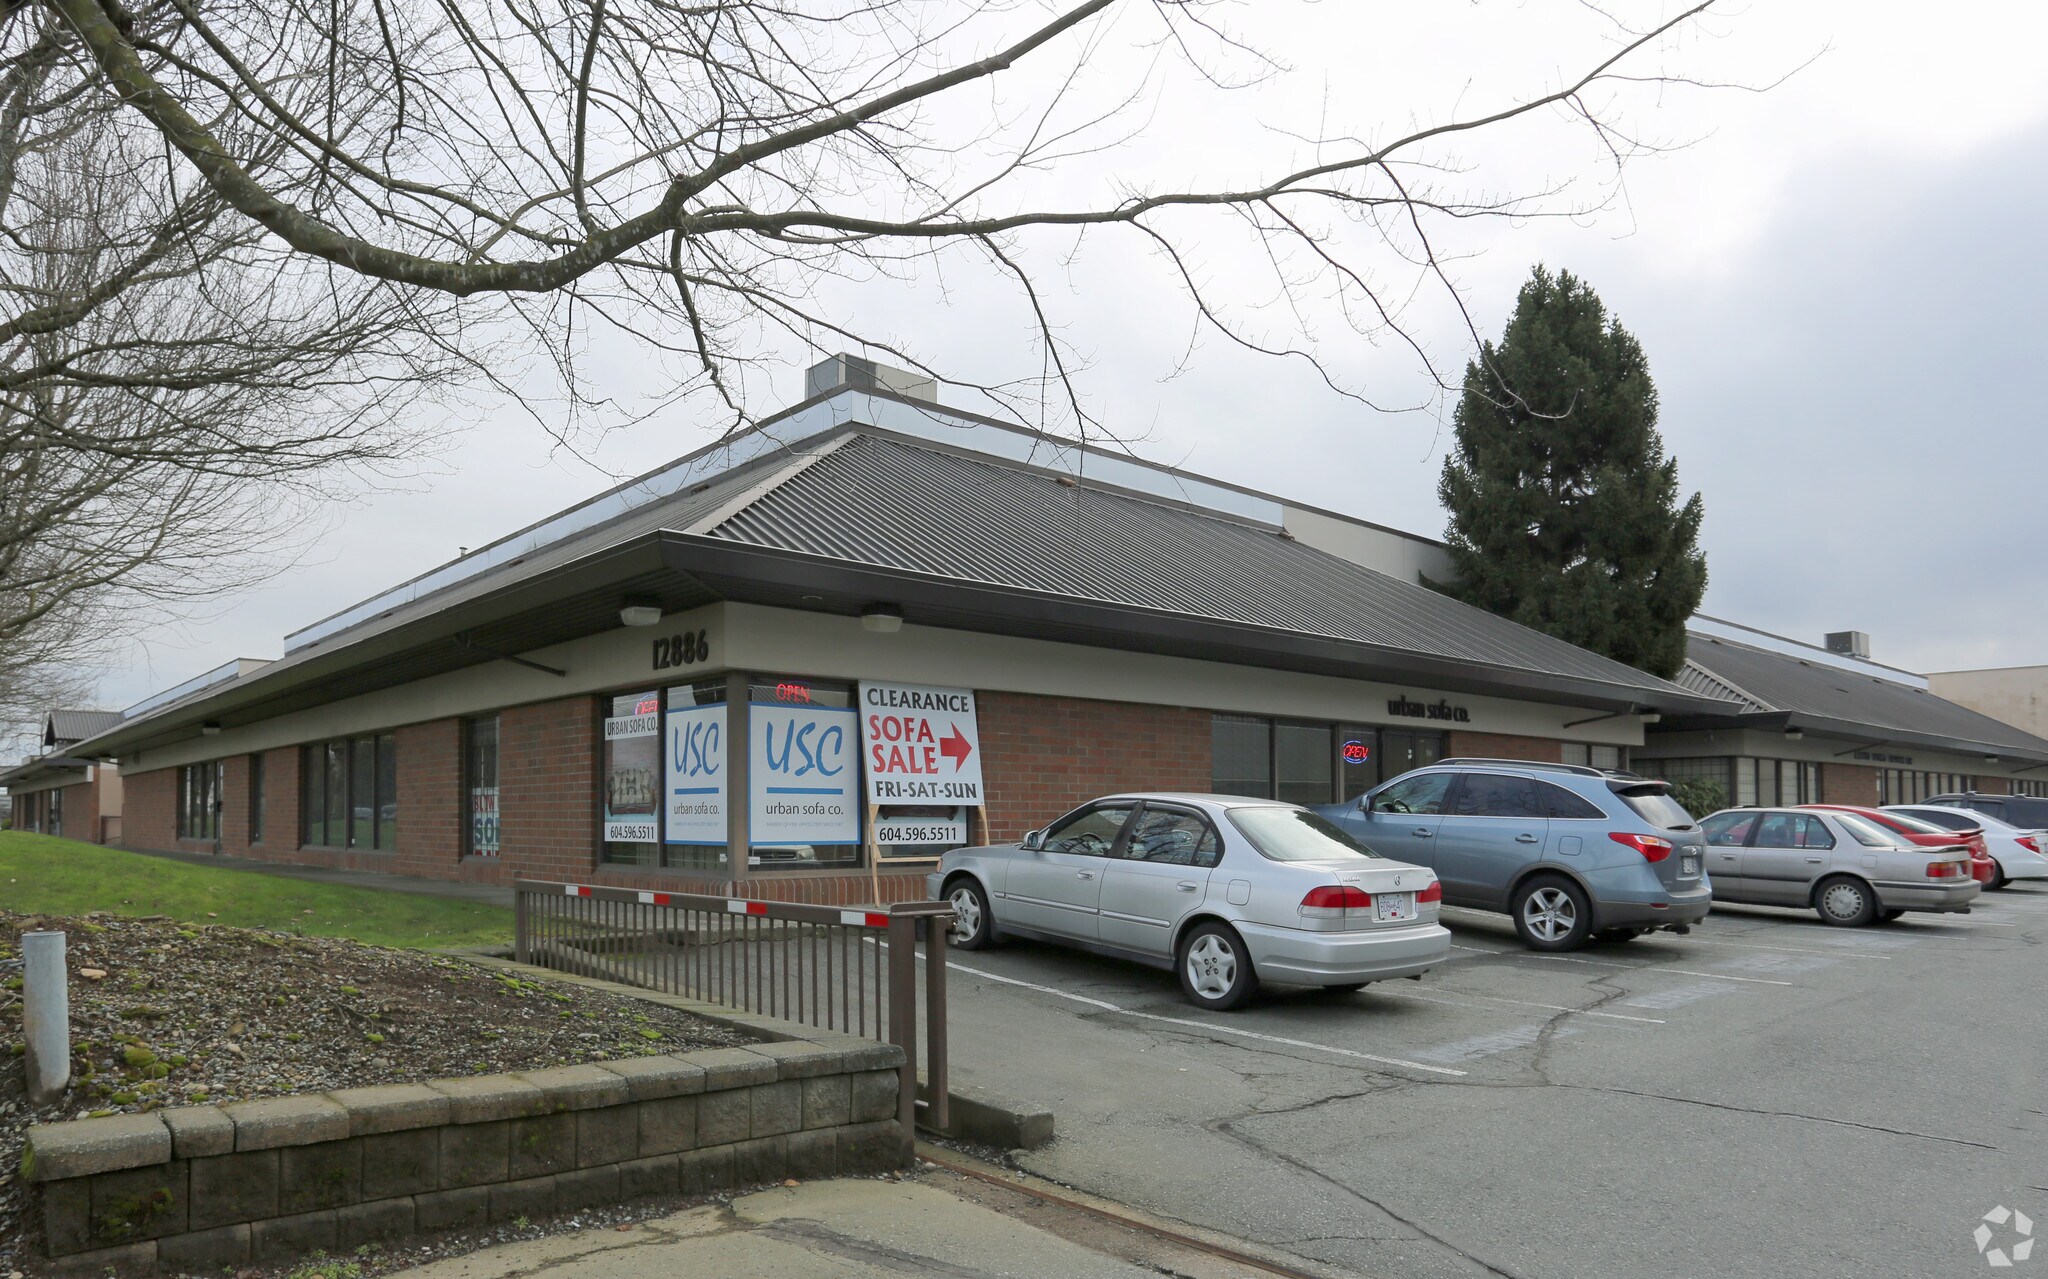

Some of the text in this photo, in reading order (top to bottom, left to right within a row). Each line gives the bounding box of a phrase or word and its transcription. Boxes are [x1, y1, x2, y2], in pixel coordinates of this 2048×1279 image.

[652, 629, 709, 670] 12886
[776, 683, 810, 702] OPEN
[867, 688, 969, 713] CLEARANCE
[1387, 695, 1471, 722] urban sofa co.
[607, 721, 628, 736] URBAN
[629, 717, 646, 734] SOFA
[869, 714, 935, 743] SOFA
[675, 721, 719, 777] USC
[766, 719, 843, 777] USC
[1343, 744, 1369, 758] OPEN
[872, 743, 939, 774] SALE
[875, 780, 977, 798] FRI-SAT-SUN
[674, 802, 720, 815] urban sofa co.
[766, 802, 844, 815] urban sofa co.
[610, 825, 654, 839] 604.596.5511
[879, 827, 957, 841] 604.596.5511
